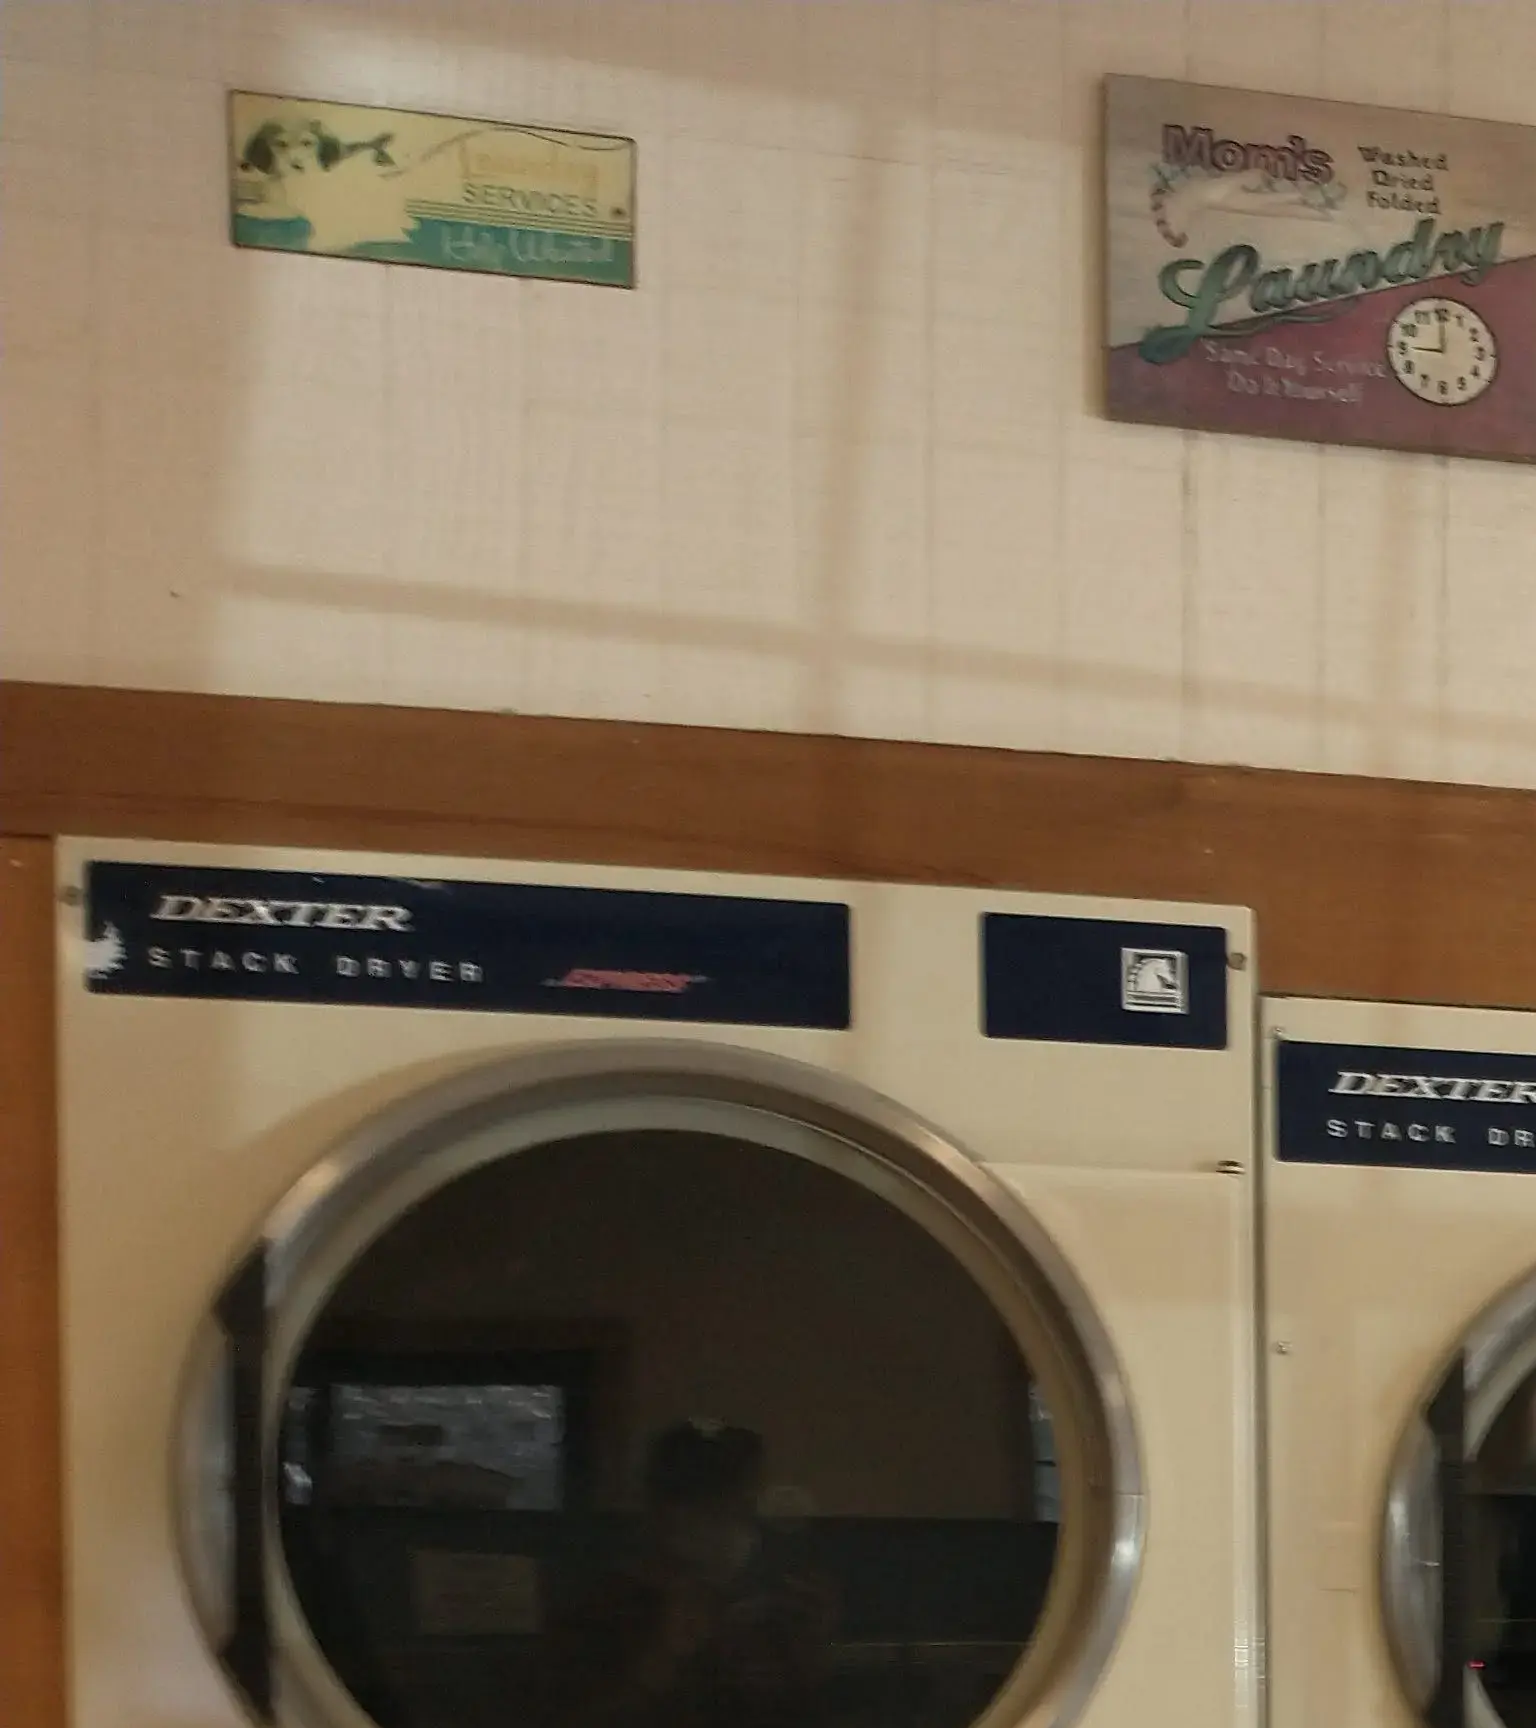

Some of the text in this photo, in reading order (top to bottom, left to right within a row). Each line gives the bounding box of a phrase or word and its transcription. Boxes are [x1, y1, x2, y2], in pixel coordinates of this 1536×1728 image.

[1161, 124, 1334, 184] Mom's
[1357, 146, 1449, 171] Washed
[1372, 170, 1434, 191] Dried
[1138, 218, 1504, 363] Laundry
[150, 895, 416, 932] DEXTER
[148, 947, 484, 982] STACK DRYER
[1326, 1119, 1456, 1144] STACK
